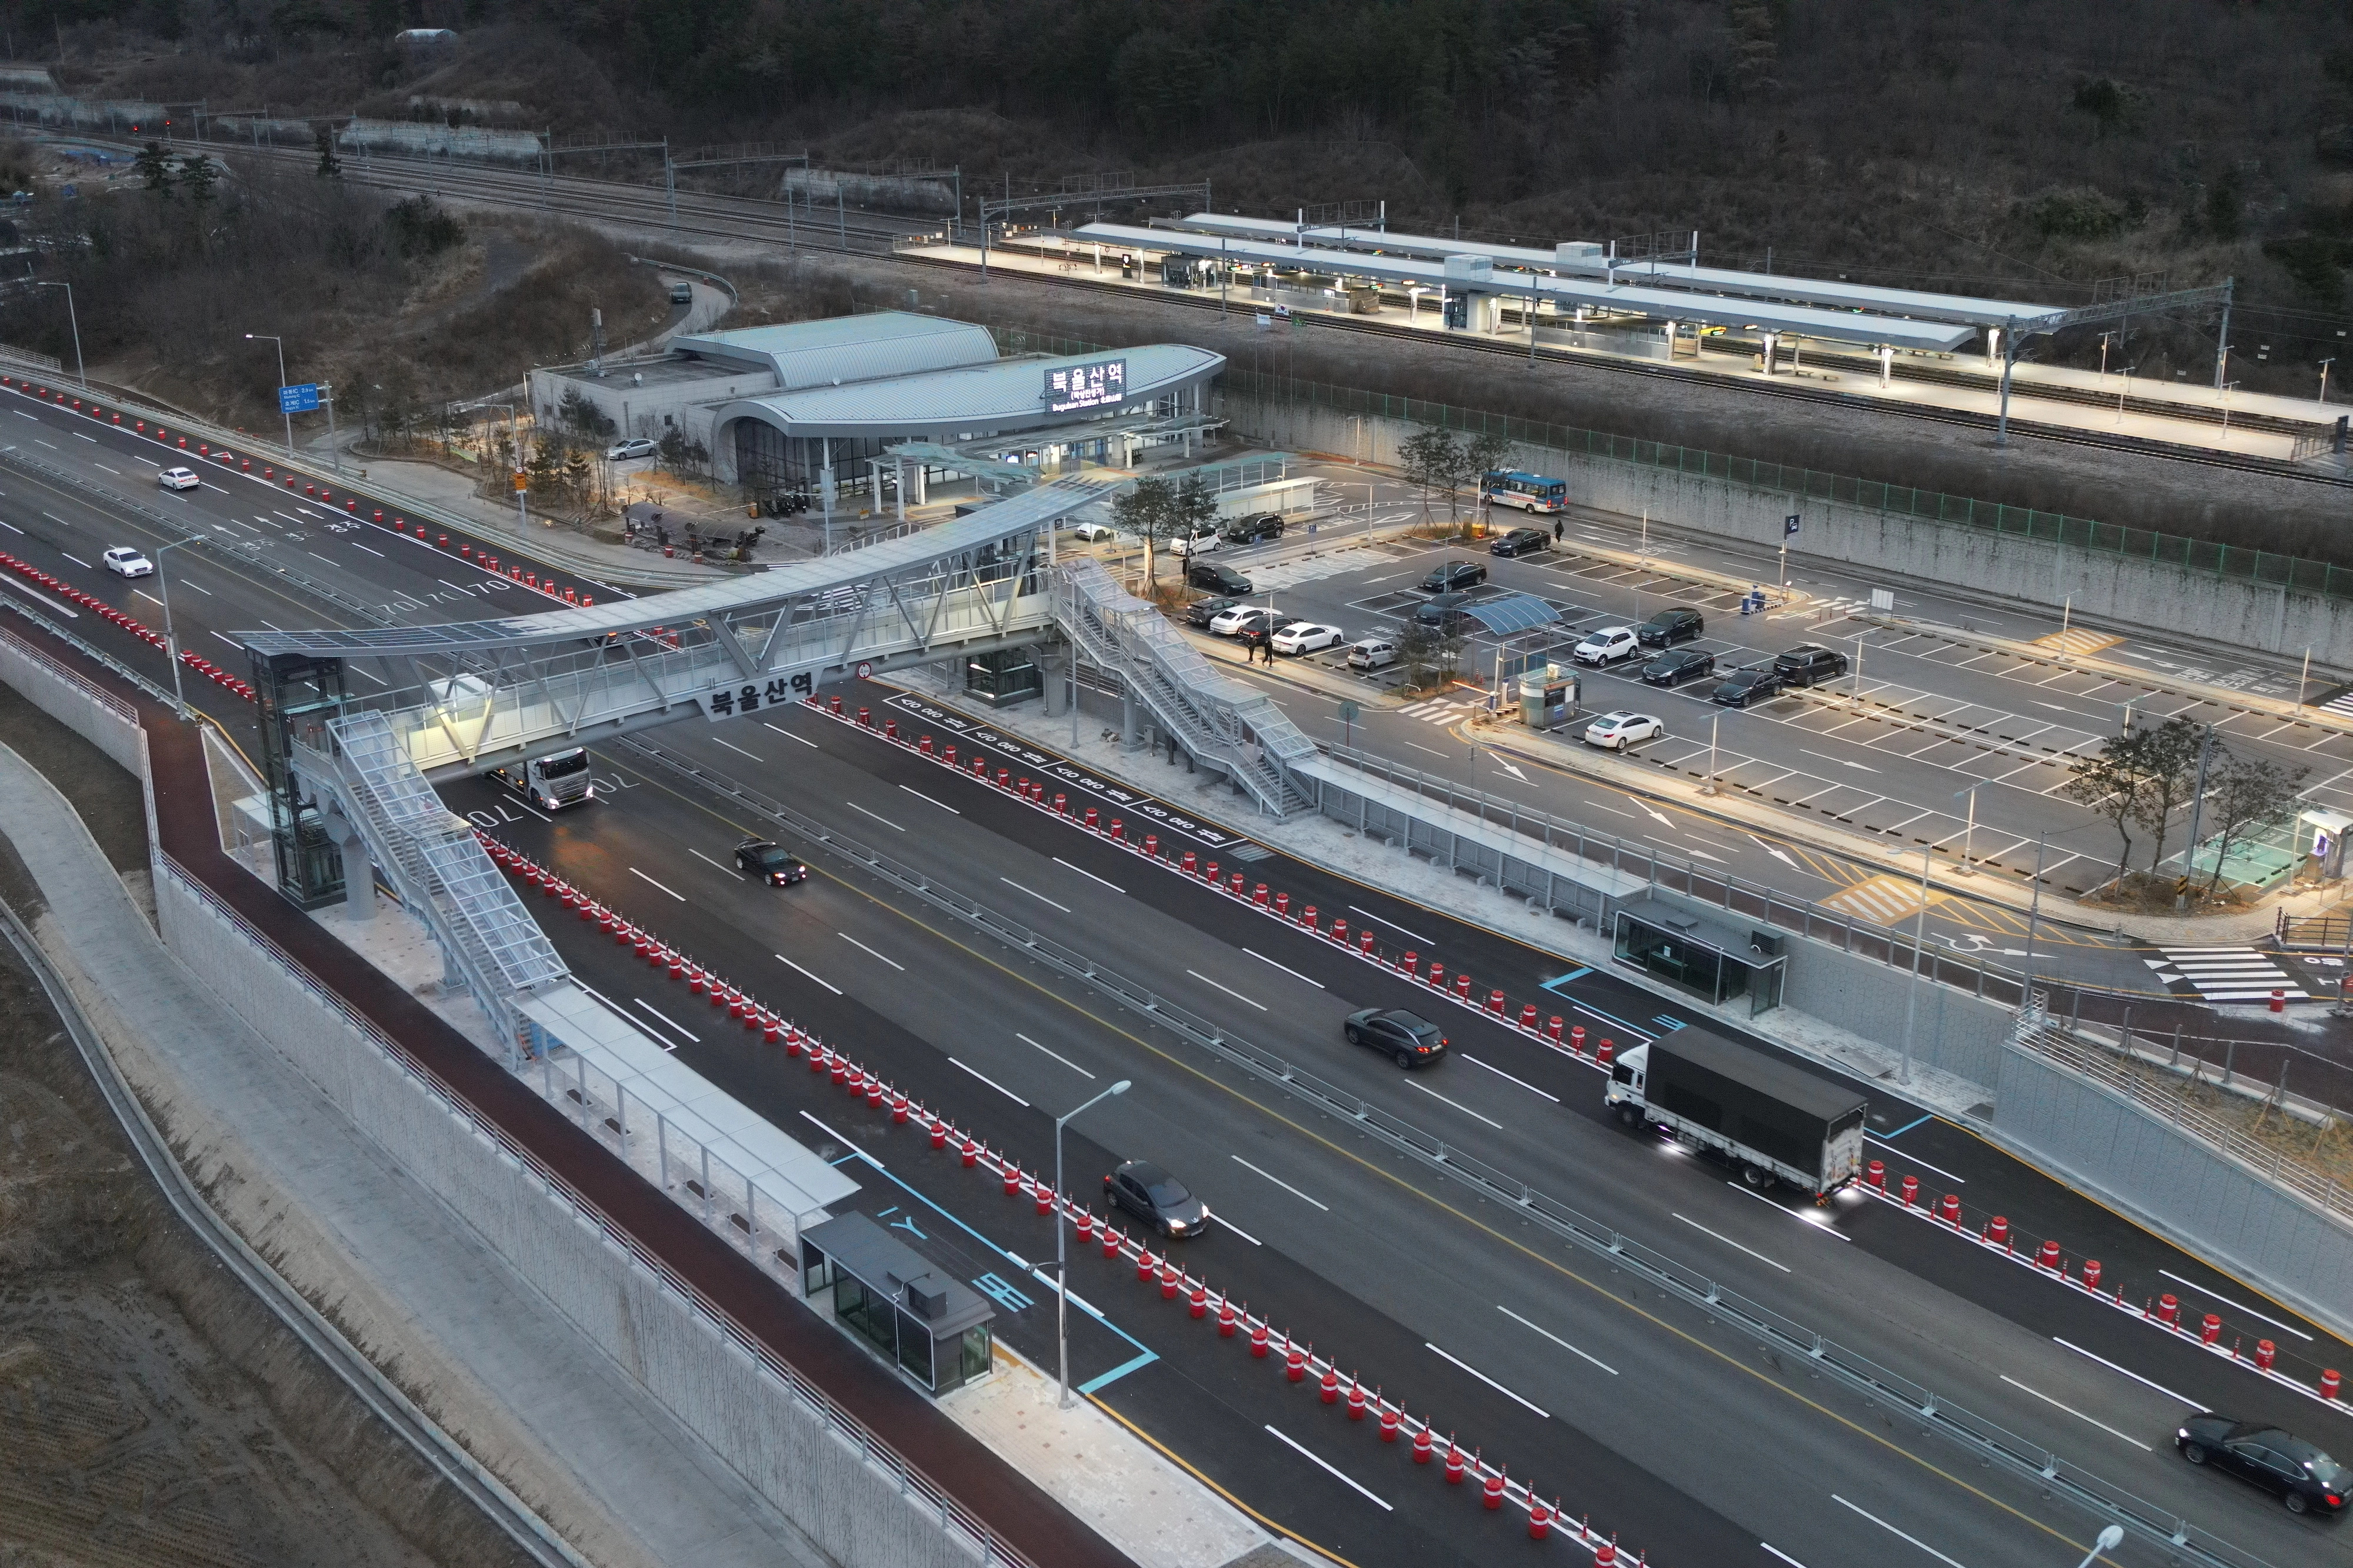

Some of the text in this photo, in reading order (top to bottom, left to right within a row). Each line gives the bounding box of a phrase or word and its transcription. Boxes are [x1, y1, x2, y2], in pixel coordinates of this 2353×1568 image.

[1053, 363, 1122, 392] 북울산역
[1052, 401, 1079, 412] Bugulsan
[1079, 398, 1099, 408] Station
[324, 521, 361, 533] 경주
[1789, 519, 1794, 527] P
[467, 581, 511, 594] 70
[422, 590, 463, 604] 70
[377, 601, 418, 615] 70
[711, 672, 812, 715] 북울산역
[590, 772, 641, 795] 70
[467, 805, 524, 828] 70
